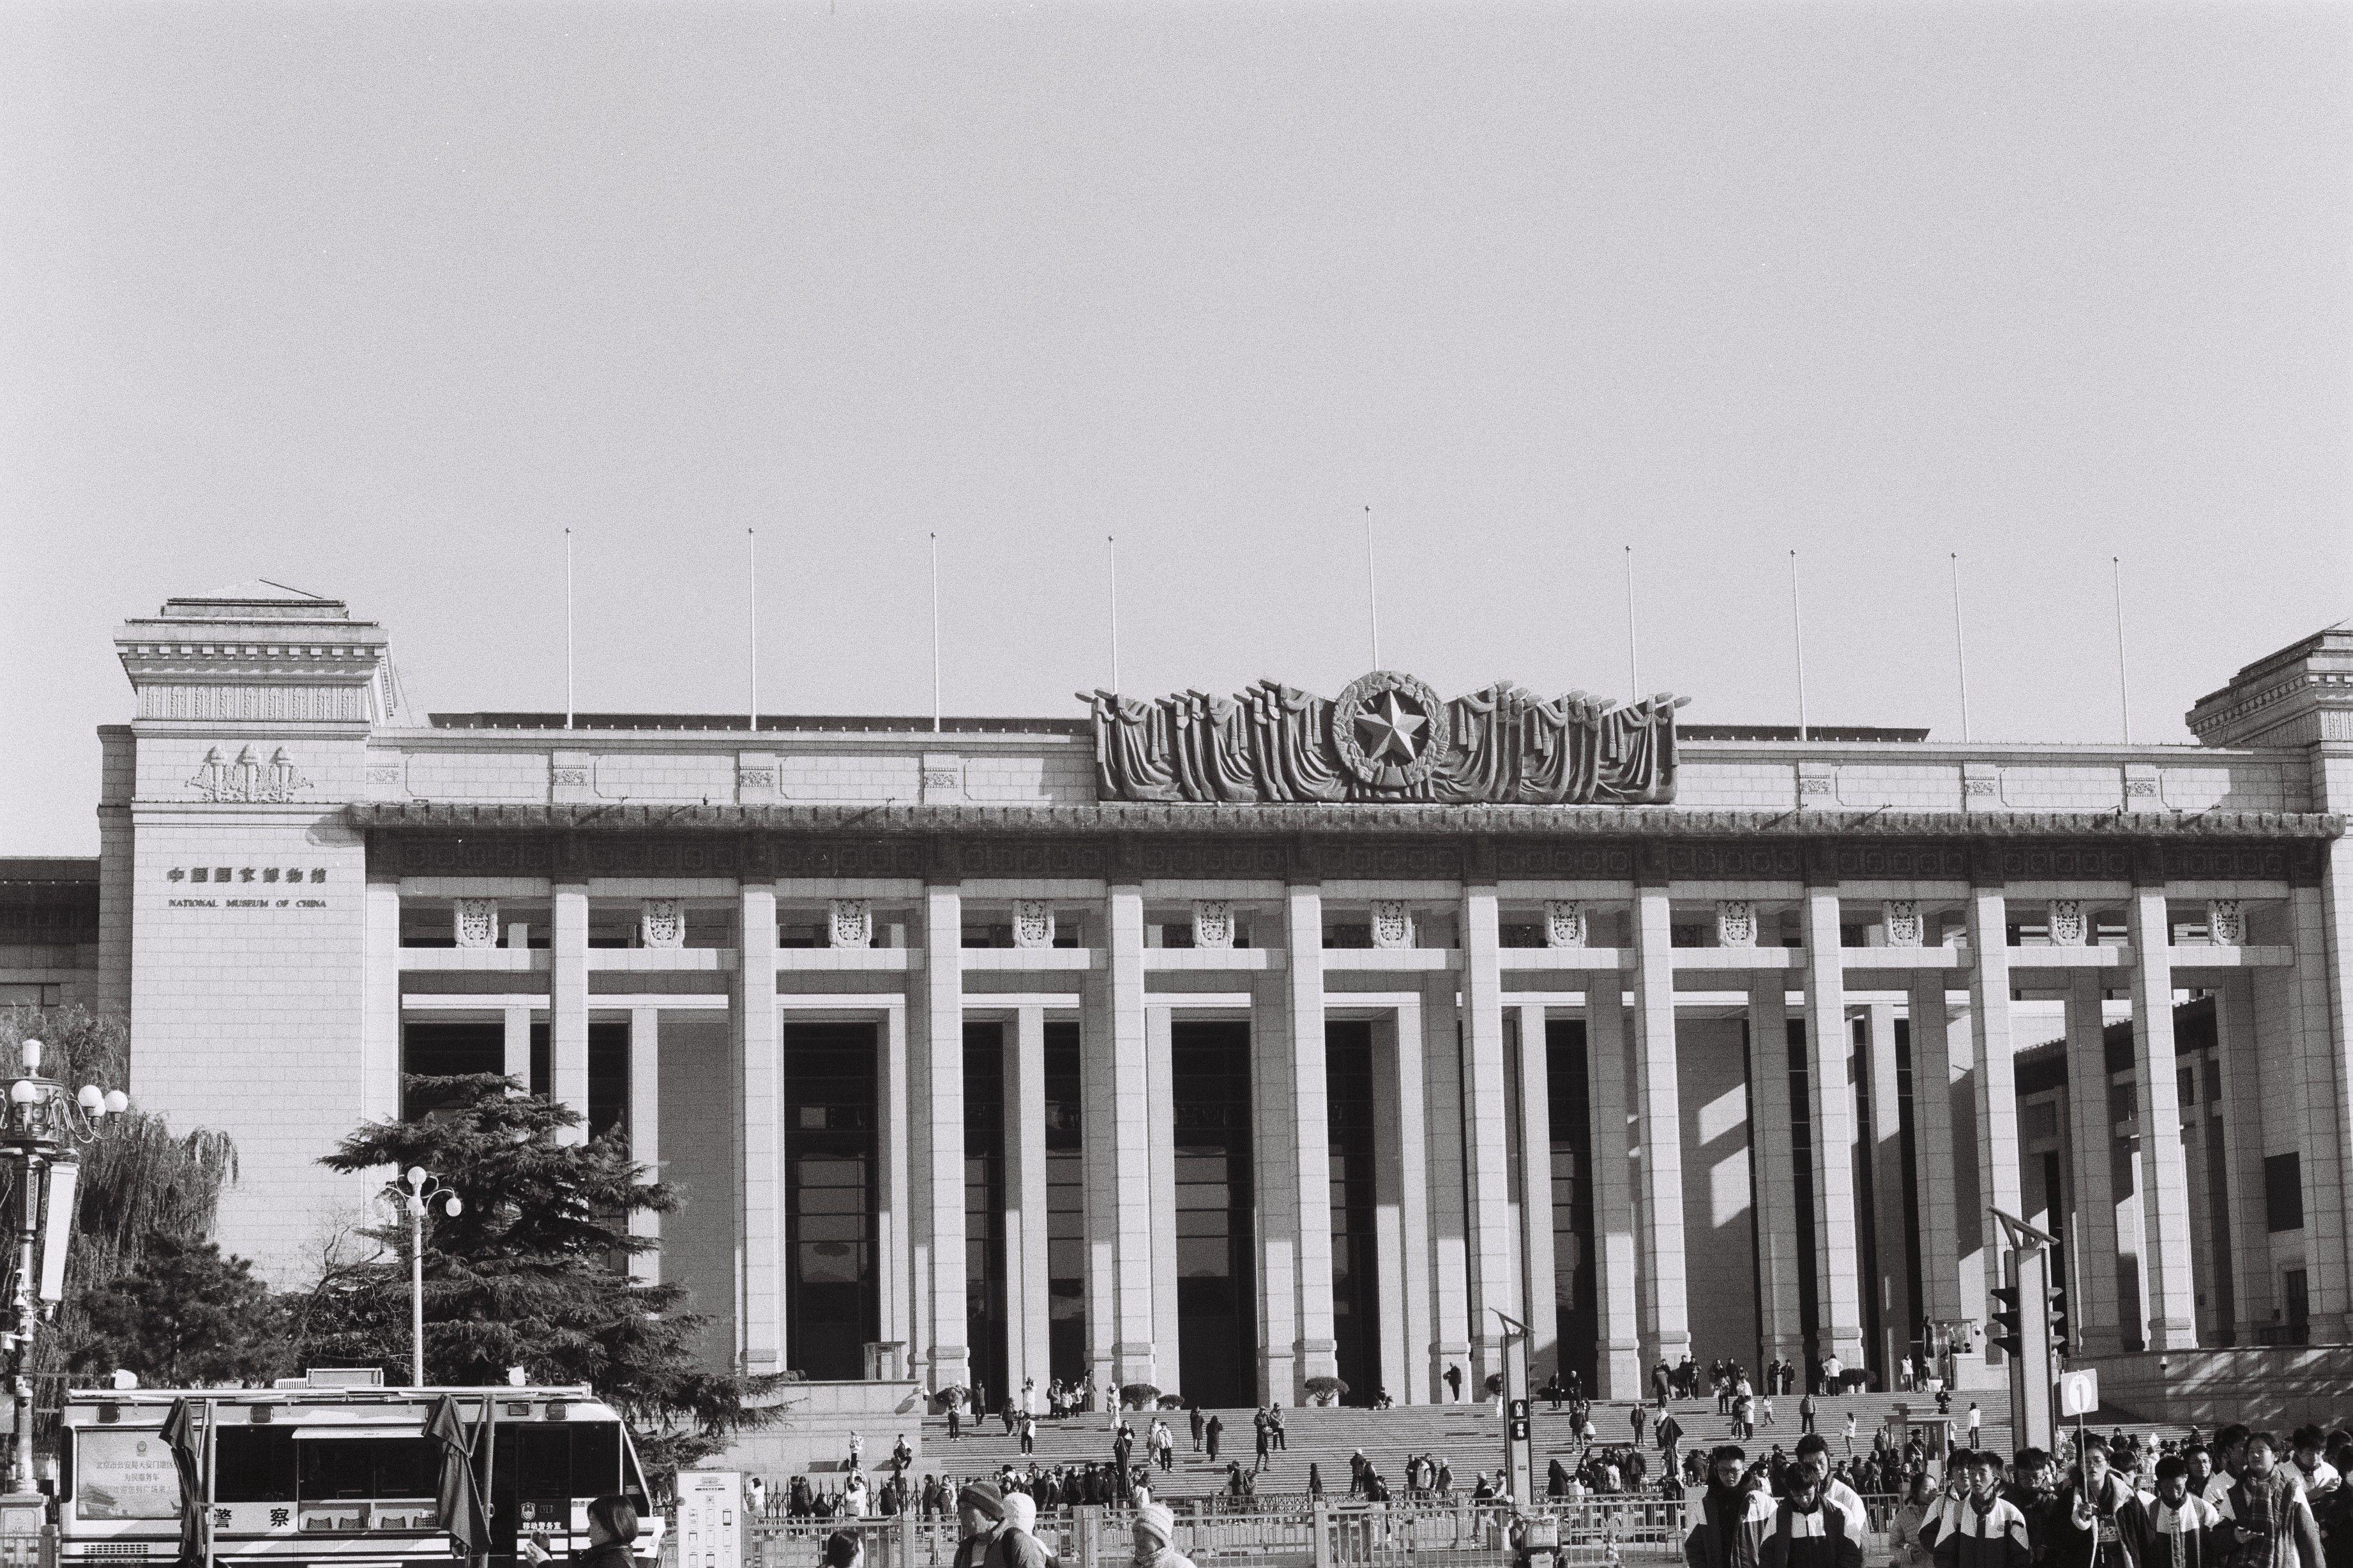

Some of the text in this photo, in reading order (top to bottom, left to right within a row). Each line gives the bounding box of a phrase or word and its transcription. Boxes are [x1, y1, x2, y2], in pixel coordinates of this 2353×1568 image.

[166, 867, 326, 883] 中国国家博物馆
[96, 1460, 177, 1469] 北京市公安局天安门地区
[214, 1508, 289, 1528] 警察
[522, 1521, 561, 1530] 移动警务室
